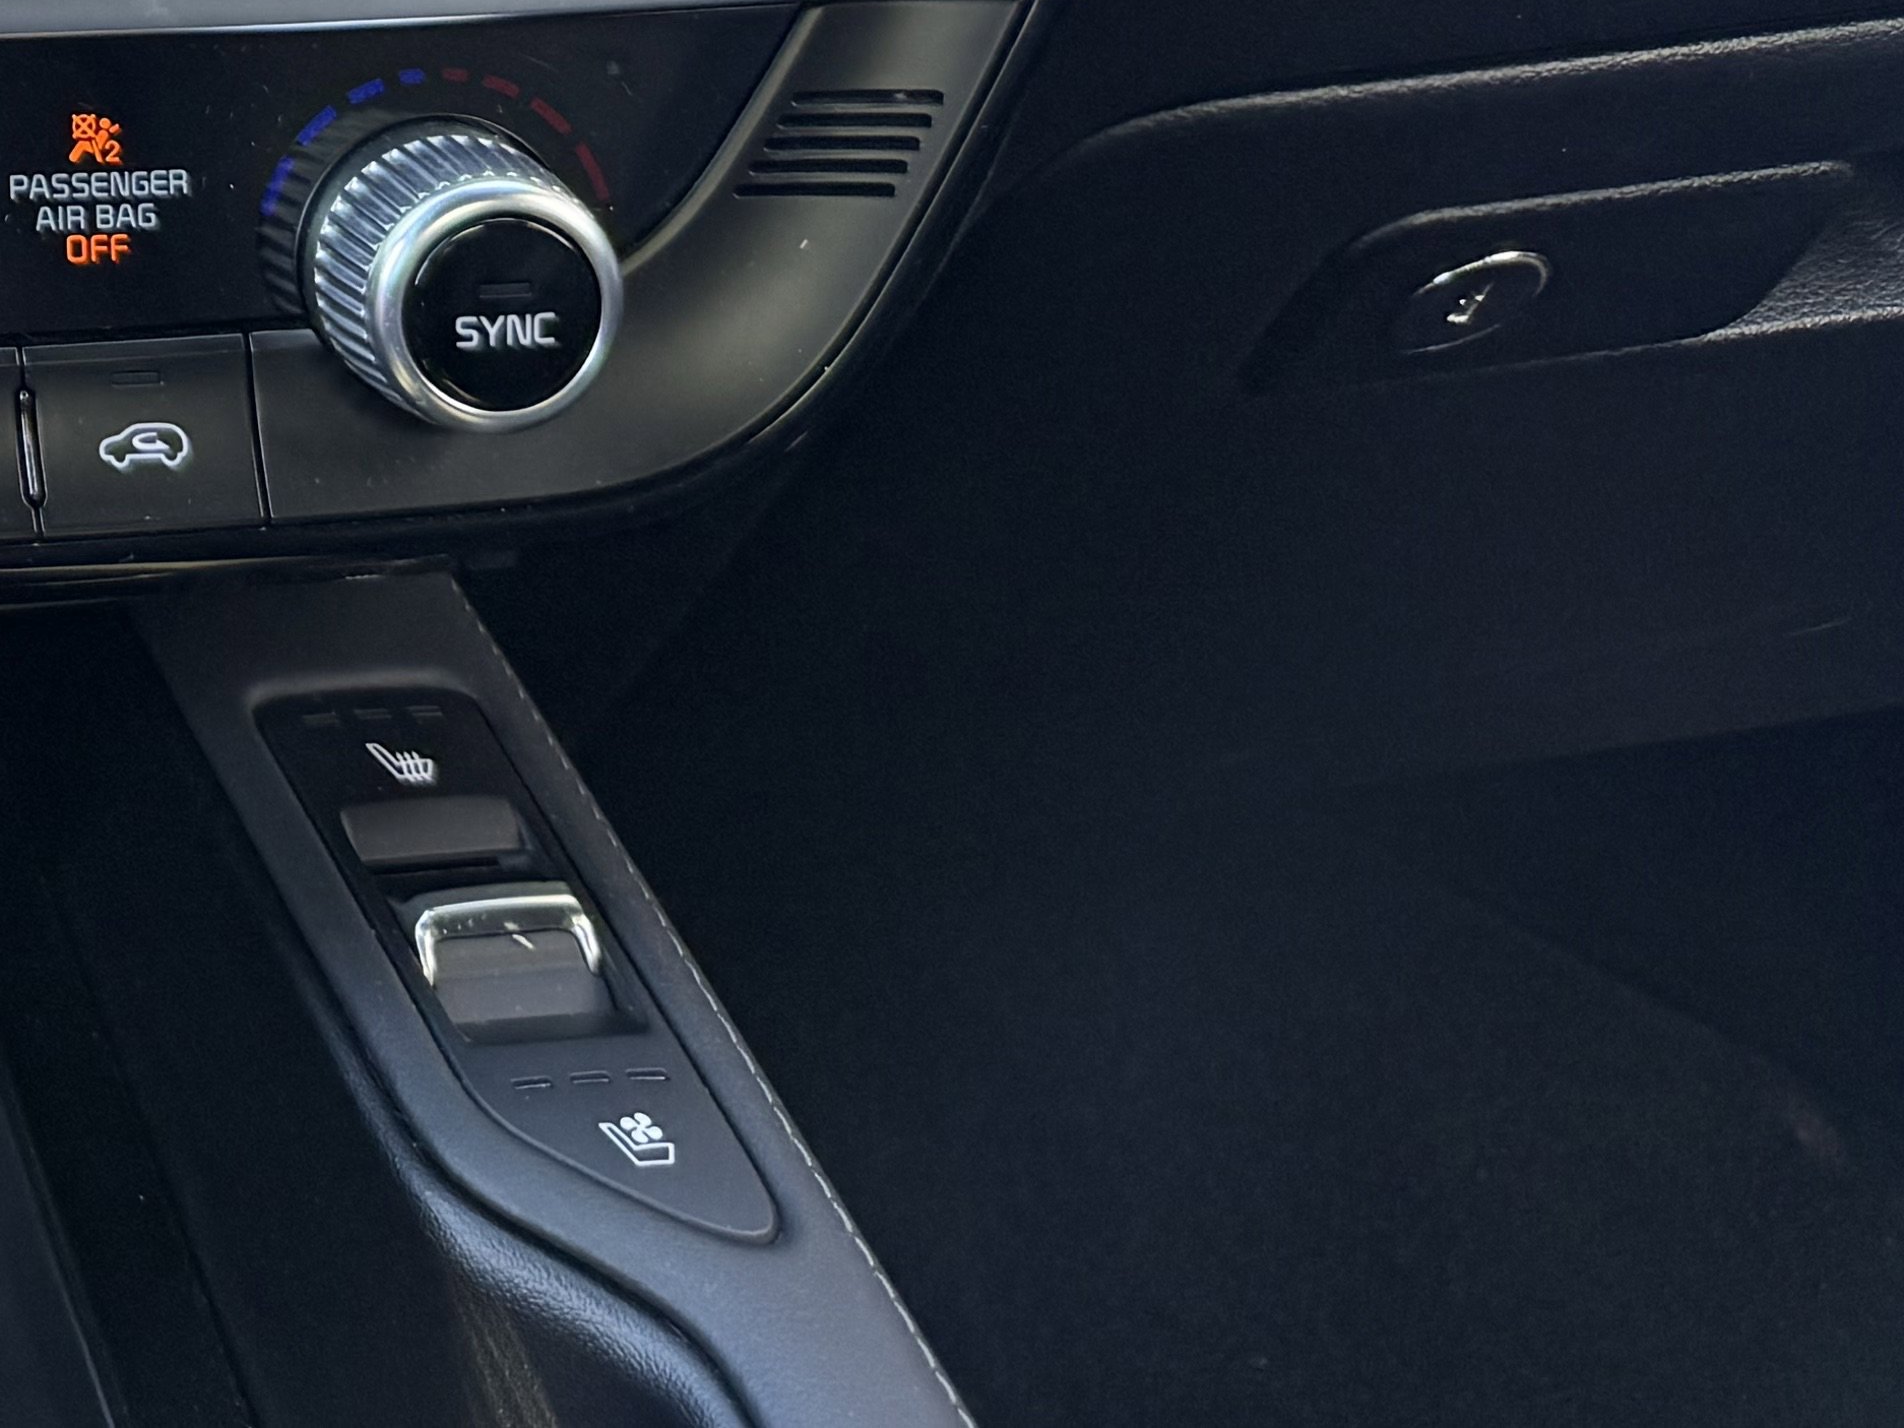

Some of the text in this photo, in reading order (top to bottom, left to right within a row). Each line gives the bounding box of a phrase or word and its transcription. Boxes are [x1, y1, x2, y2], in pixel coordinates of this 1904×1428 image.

[9, 169, 191, 200] PASSENGER
[35, 203, 159, 232] AIR BAG
[65, 233, 130, 265] OFF
[455, 310, 558, 348] SYNC
